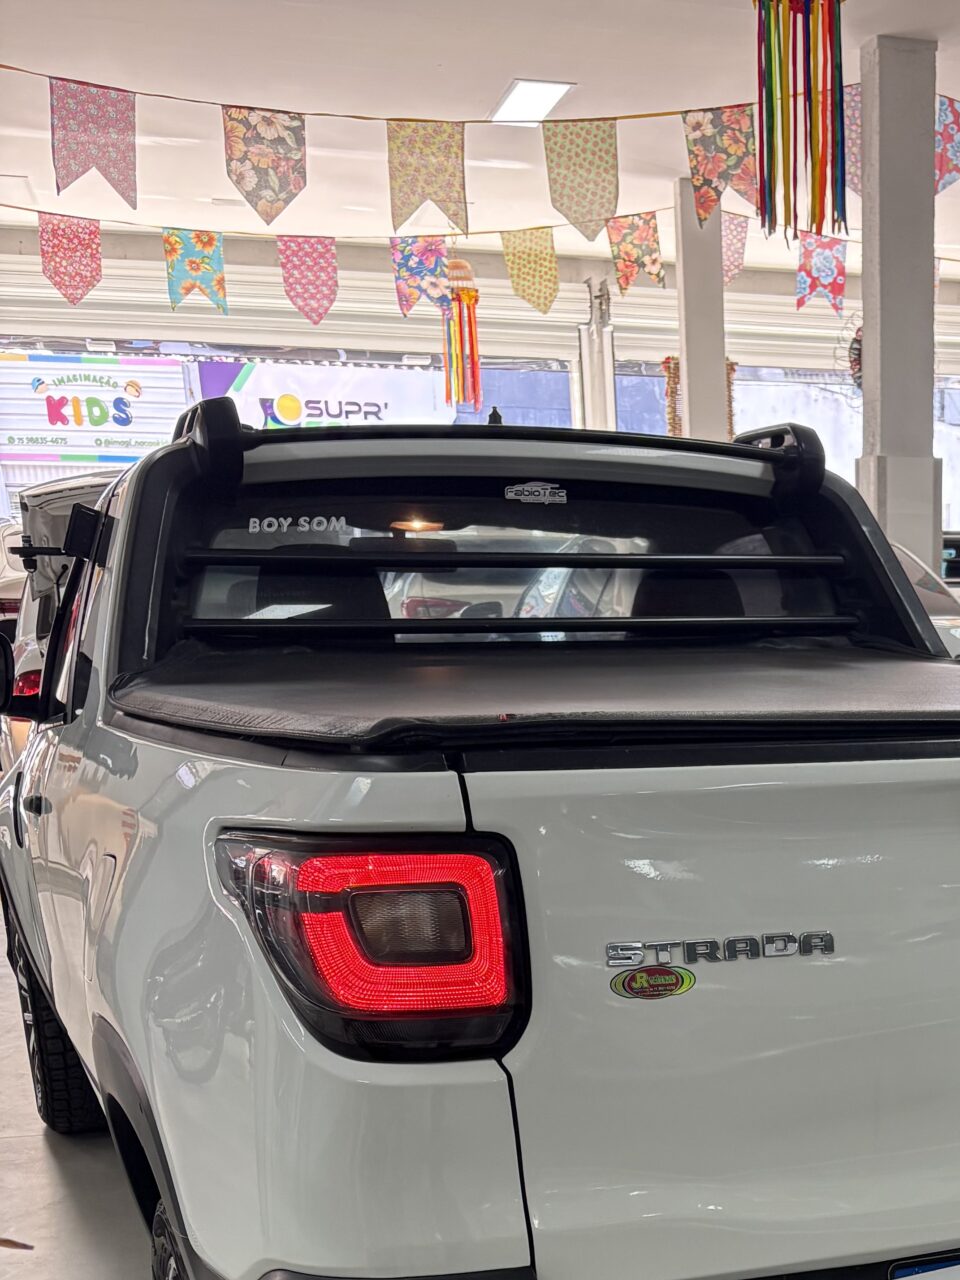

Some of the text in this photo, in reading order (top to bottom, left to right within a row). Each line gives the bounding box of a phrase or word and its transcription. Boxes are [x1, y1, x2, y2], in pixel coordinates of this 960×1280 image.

[52, 373, 119, 389] IMAGINAÇÃO
[45, 395, 133, 427] KIDS
[248, 515, 347, 534] BOY SOM
[606, 930, 835, 968] STRADA
